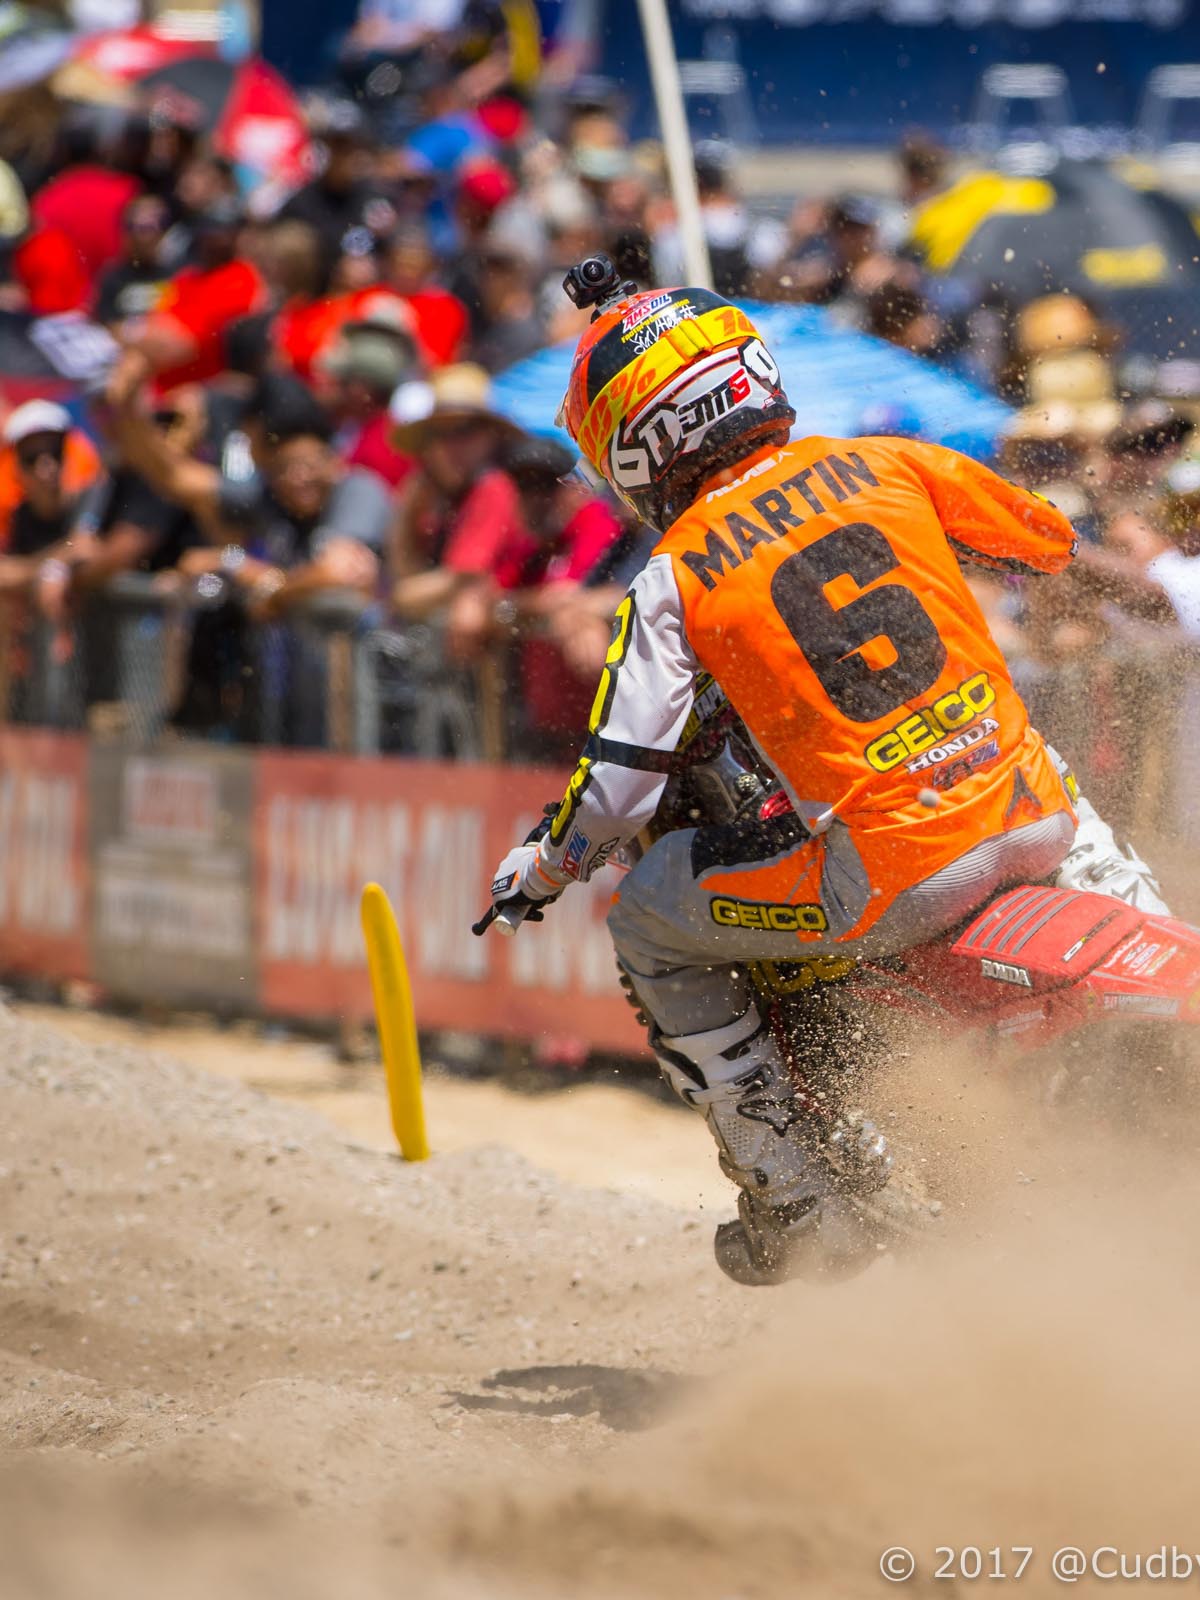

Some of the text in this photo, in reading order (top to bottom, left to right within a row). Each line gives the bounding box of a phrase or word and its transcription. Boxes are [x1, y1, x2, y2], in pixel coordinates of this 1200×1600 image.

[622, 294, 672, 334] AMSOIL
[680, 452, 881, 592] MARTIN
[771, 522, 948, 723] 6
[864, 672, 996, 773] GEICO
[906, 718, 1000, 775] HONDA
[710, 897, 828, 932] GEICO
[980, 957, 1034, 988] HONDA
